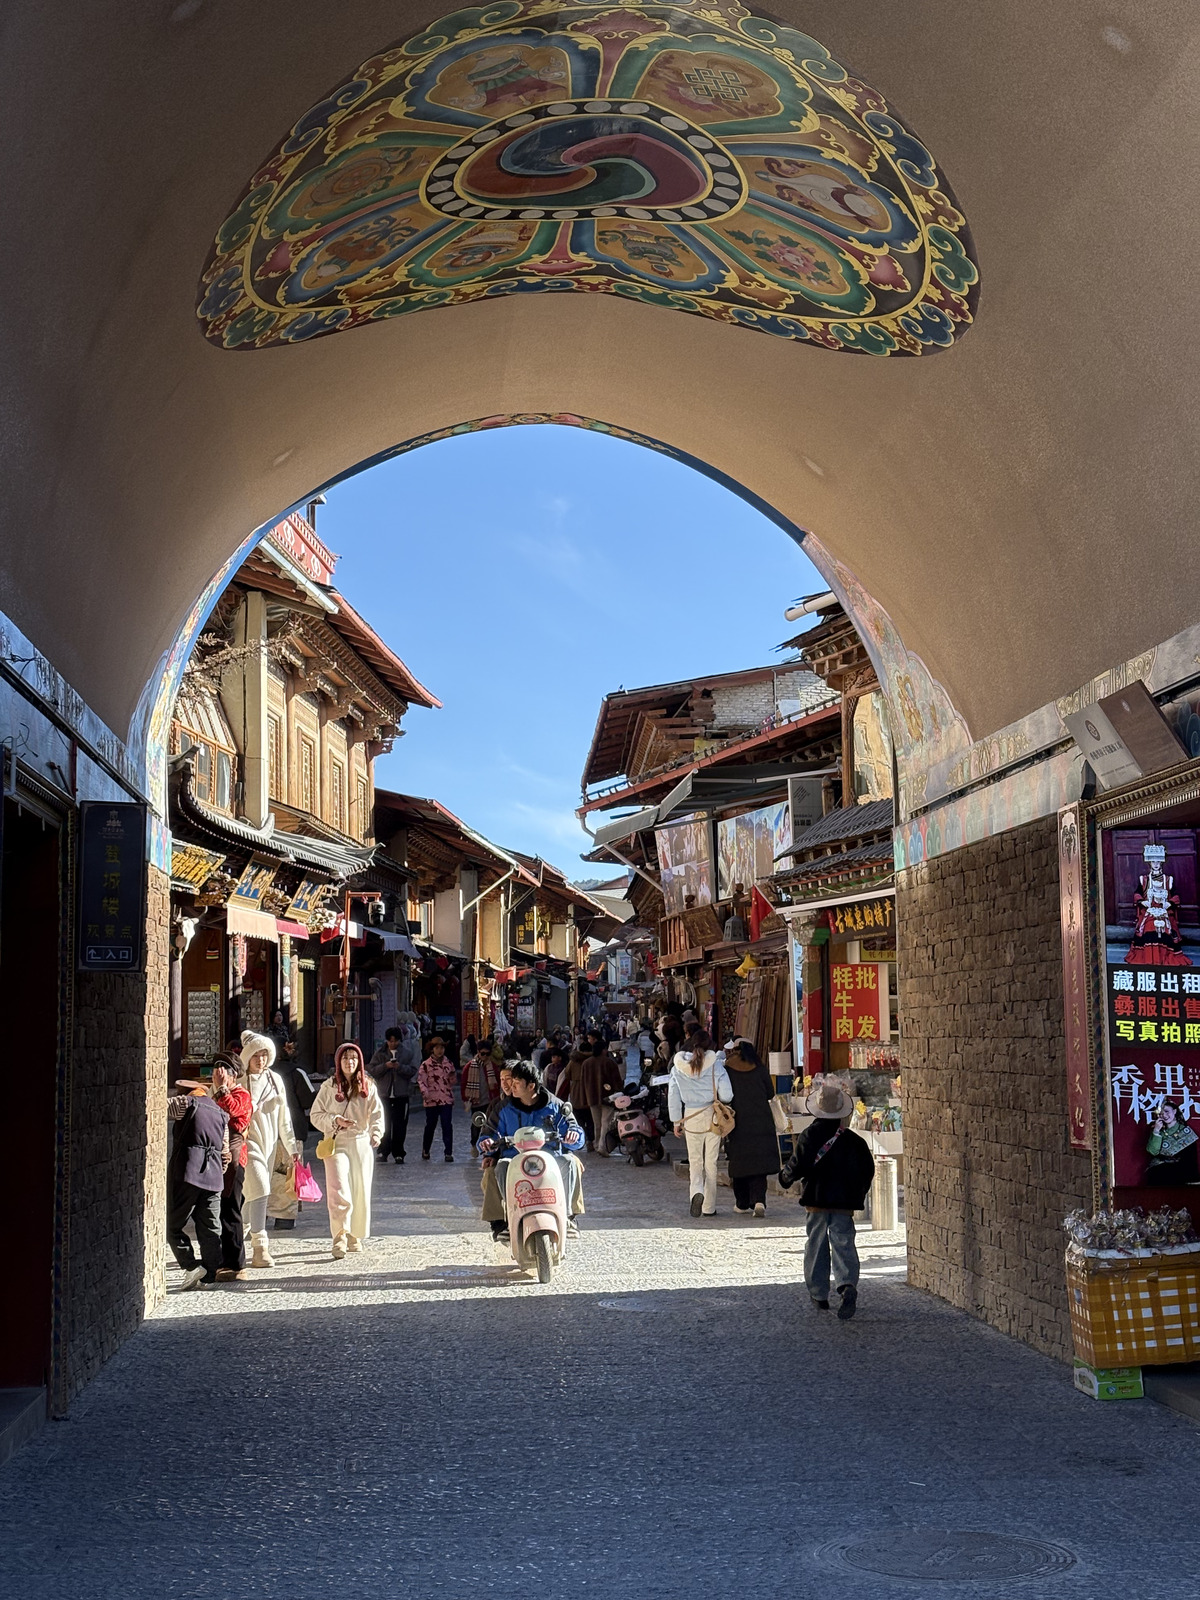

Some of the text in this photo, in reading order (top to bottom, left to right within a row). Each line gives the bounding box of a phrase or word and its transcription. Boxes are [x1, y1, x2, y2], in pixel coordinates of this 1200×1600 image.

[105, 948, 129, 960] 入口
[1112, 970, 1200, 994] 藏服出租
[833, 966, 854, 1039] 牦牛肉
[1113, 994, 1200, 1019] 彝服出售
[1115, 1020, 1200, 1044] 写真拍照
